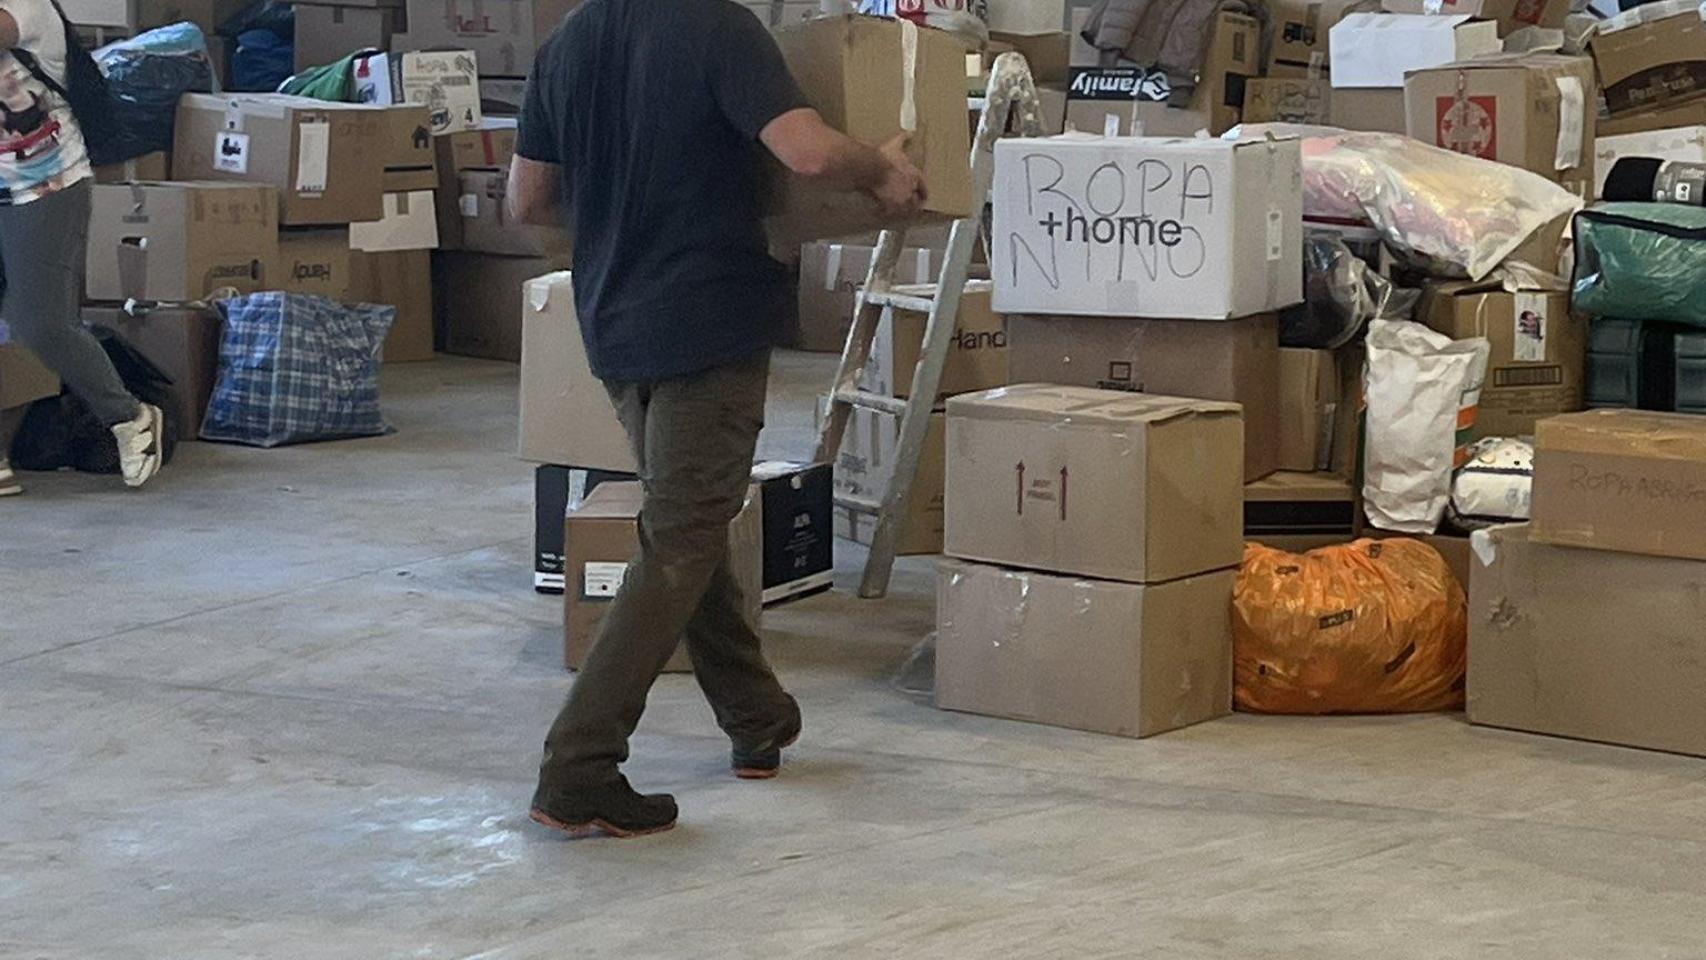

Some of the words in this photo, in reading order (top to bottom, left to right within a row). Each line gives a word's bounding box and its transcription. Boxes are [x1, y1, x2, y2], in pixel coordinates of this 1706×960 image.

[1070, 72, 1144, 96] family
[1022, 153, 1214, 220] ROPA
[1039, 206, 1182, 247] +home
